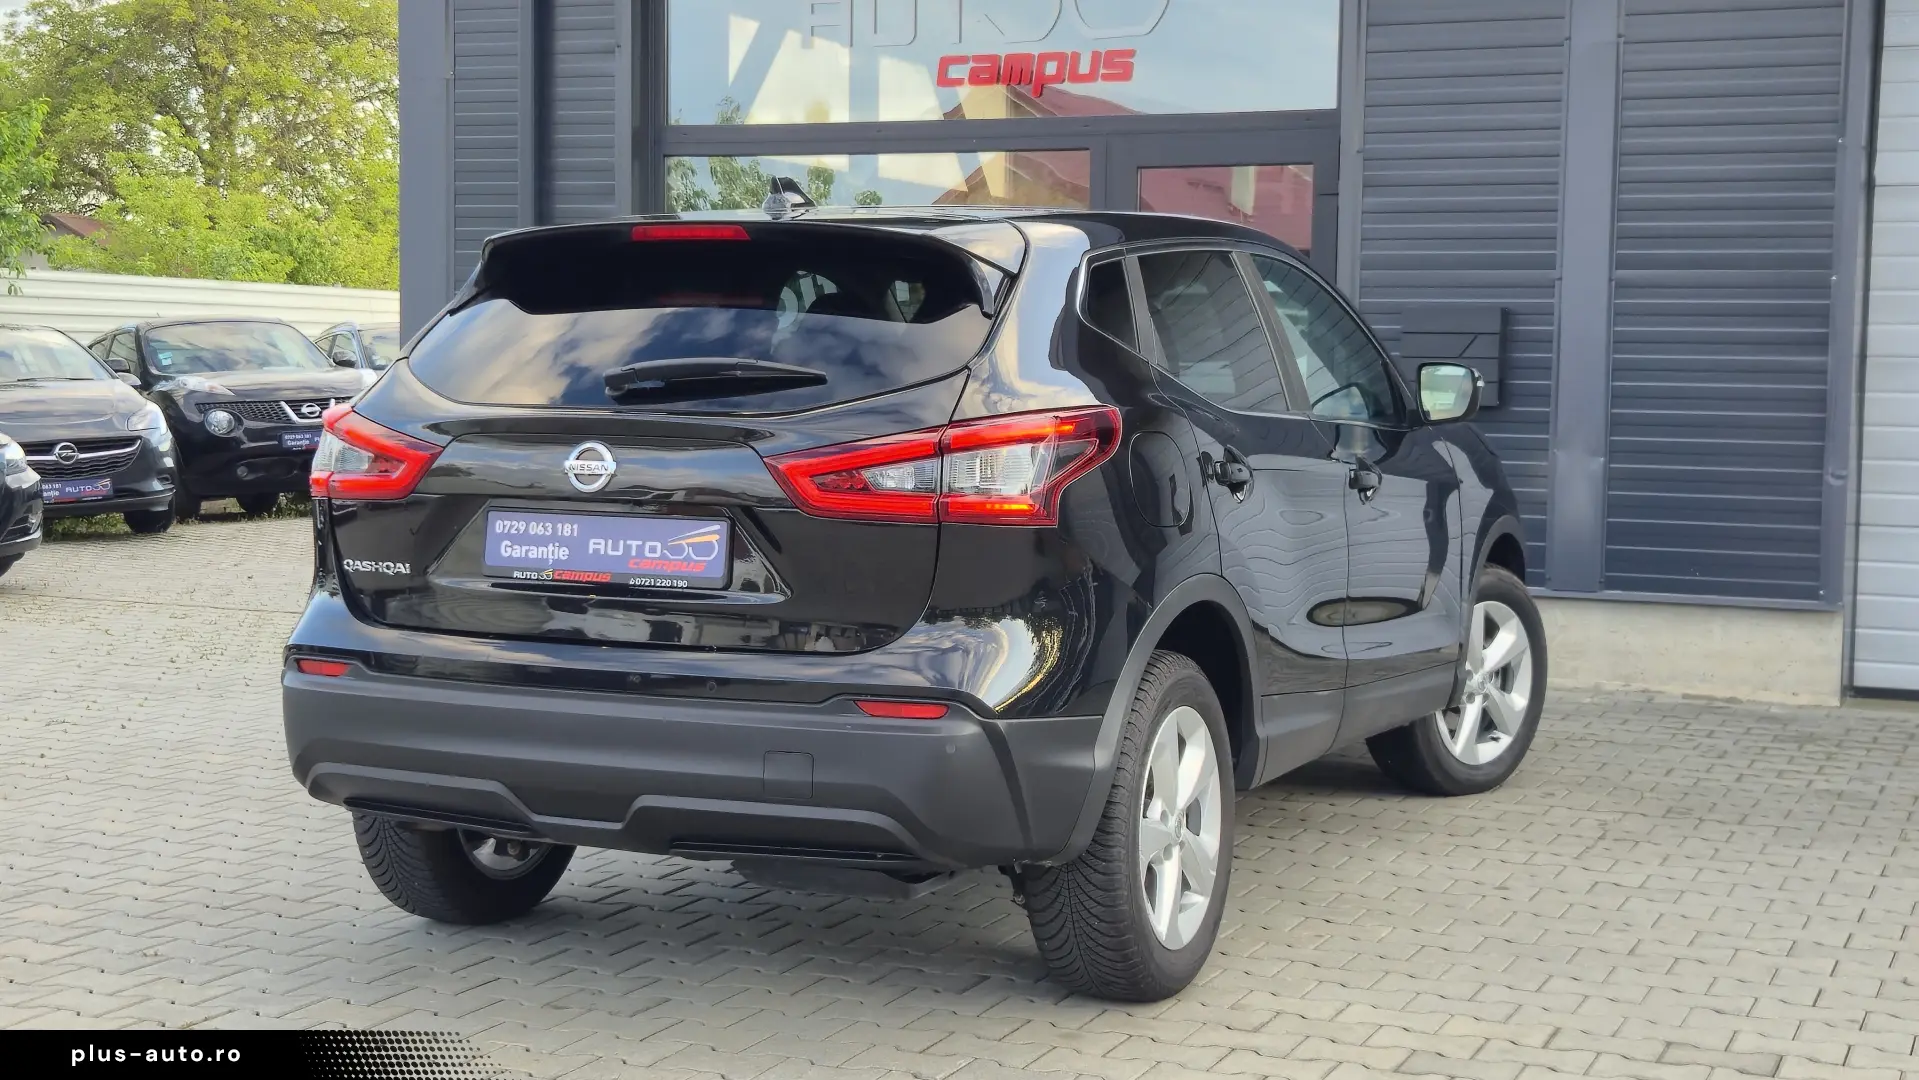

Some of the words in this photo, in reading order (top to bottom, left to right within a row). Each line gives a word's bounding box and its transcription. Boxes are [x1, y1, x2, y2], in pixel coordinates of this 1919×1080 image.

[937, 48, 1136, 97] campus
[568, 463, 609, 472] NISSAN
[495, 520, 526, 534] 0729
[529, 521, 553, 536] 063
[556, 523, 579, 537] 181
[500, 540, 570, 565] Garanție
[588, 538, 662, 558] AUTO
[343, 558, 411, 575] QASHQAI
[628, 559, 707, 572] campus
[513, 570, 538, 579] AUTO
[553, 569, 612, 582] campus
[635, 578, 655, 586] 0721
[655, 579, 672, 587] 220
